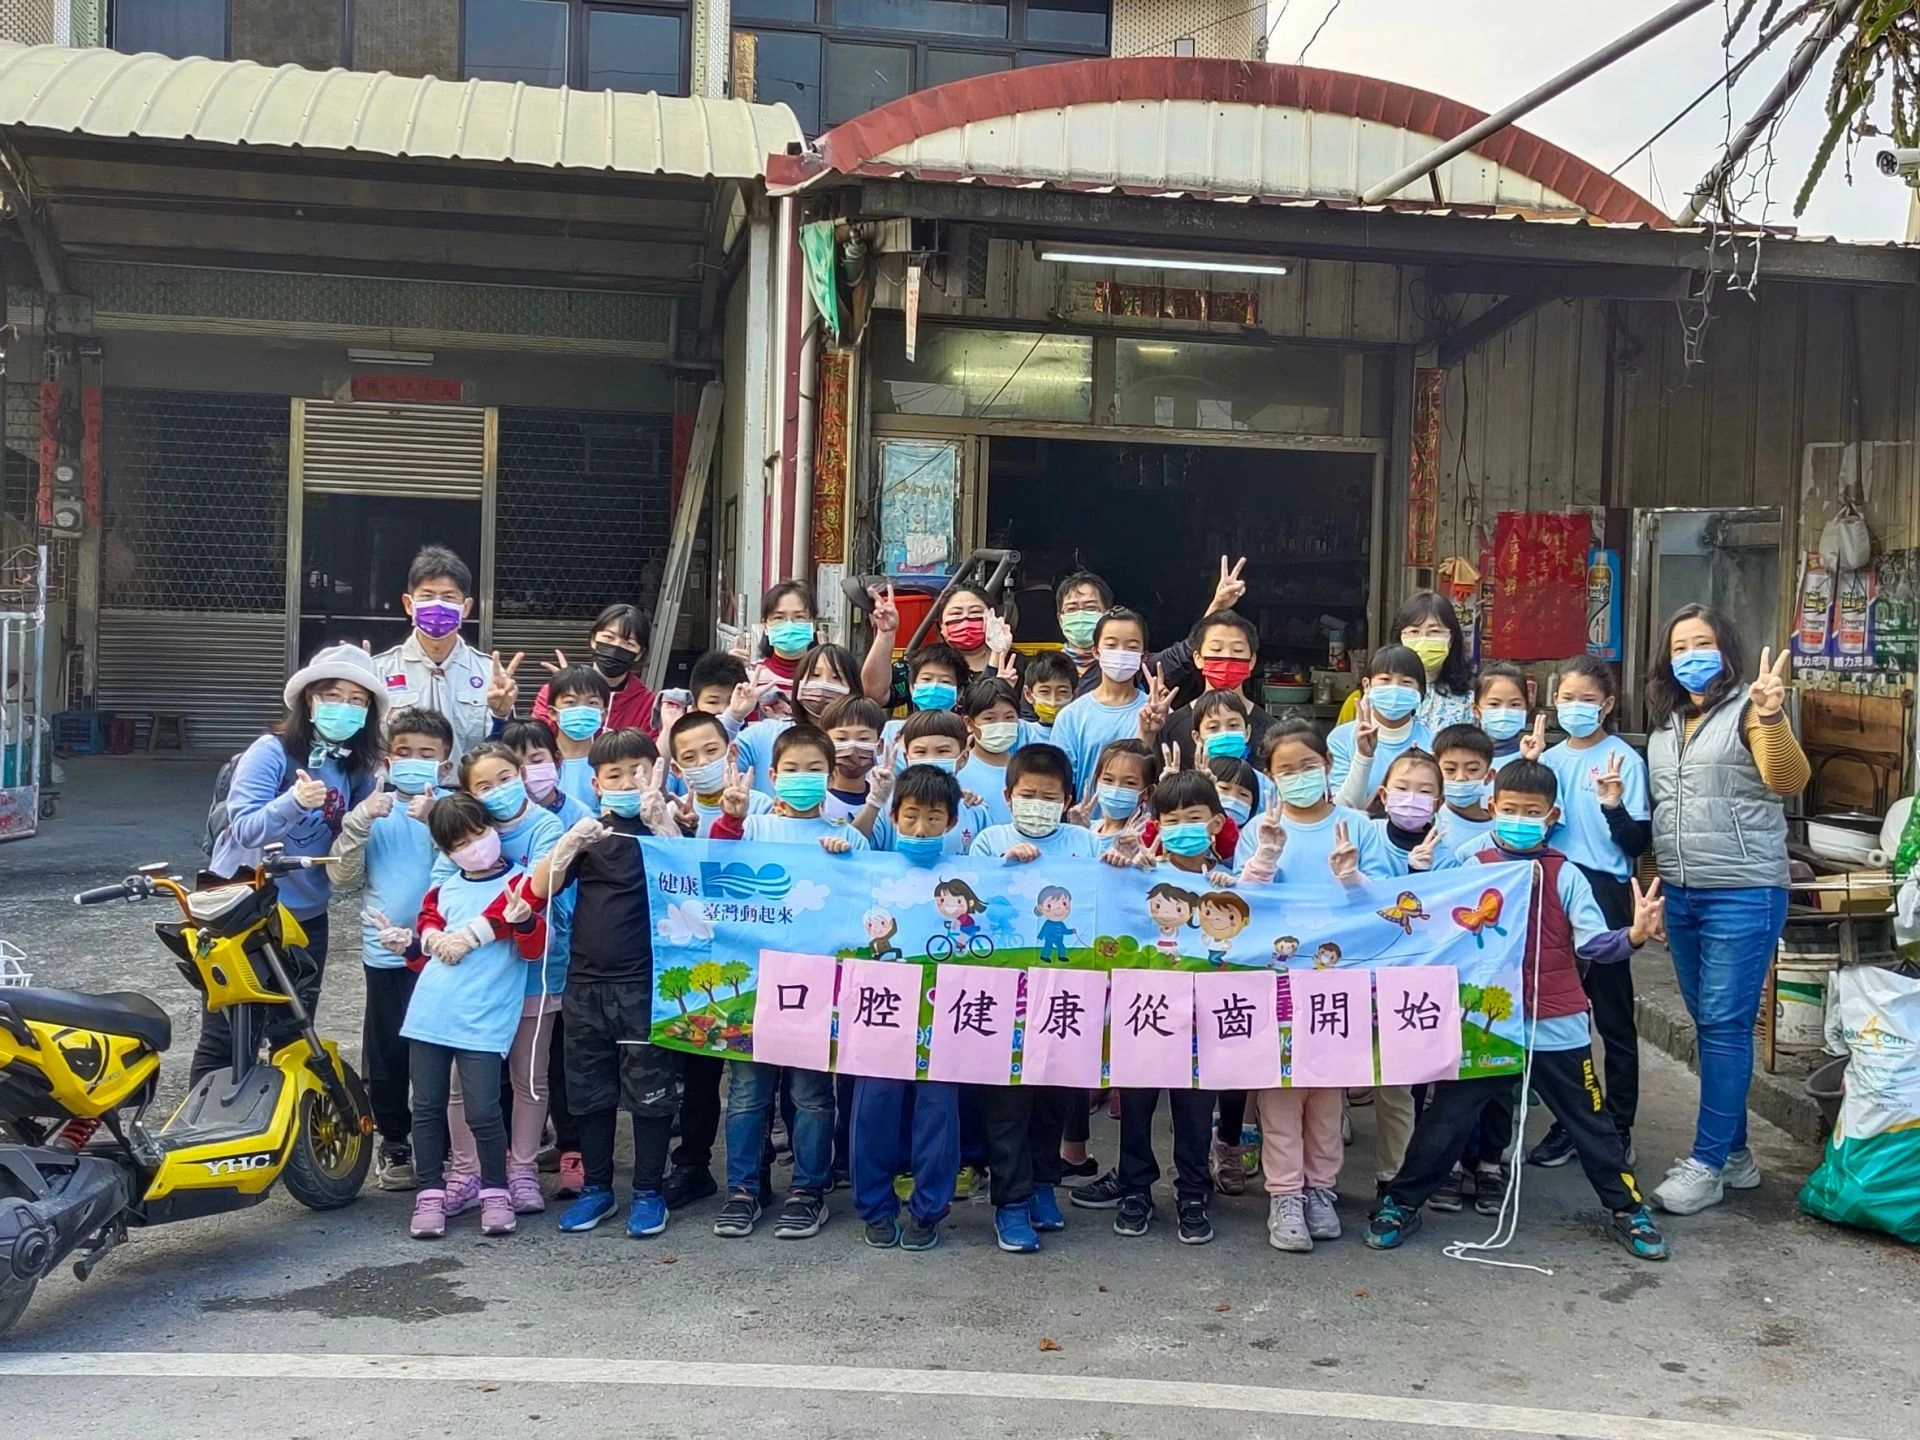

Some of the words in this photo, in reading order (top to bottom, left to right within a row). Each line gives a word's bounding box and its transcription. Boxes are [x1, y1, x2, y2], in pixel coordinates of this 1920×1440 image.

[659, 872, 699, 896] 健康
[703, 902, 793, 924] 臺灣動起來
[776, 983, 1443, 1040] 口腔健康從齒開始
[203, 1154, 270, 1176] YHC
